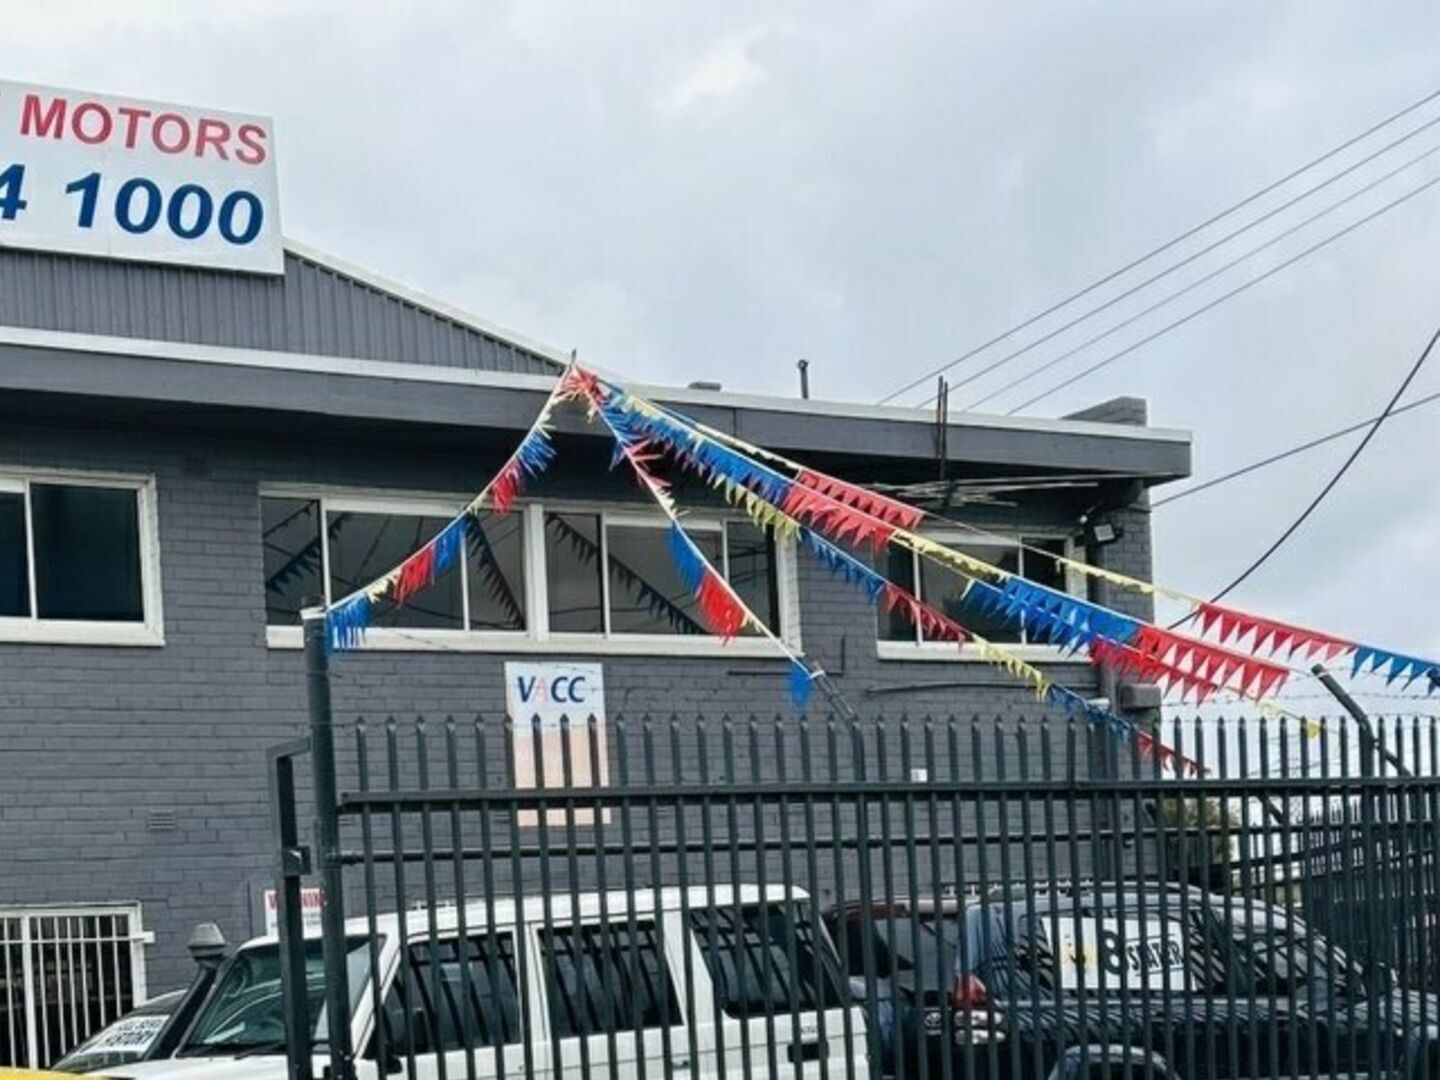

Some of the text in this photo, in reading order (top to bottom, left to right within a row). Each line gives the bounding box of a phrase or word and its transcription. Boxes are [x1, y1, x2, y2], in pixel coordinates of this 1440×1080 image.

[20, 94, 268, 164] MOTORS
[64, 172, 264, 246] 1000
[516, 675, 586, 704] VACC
